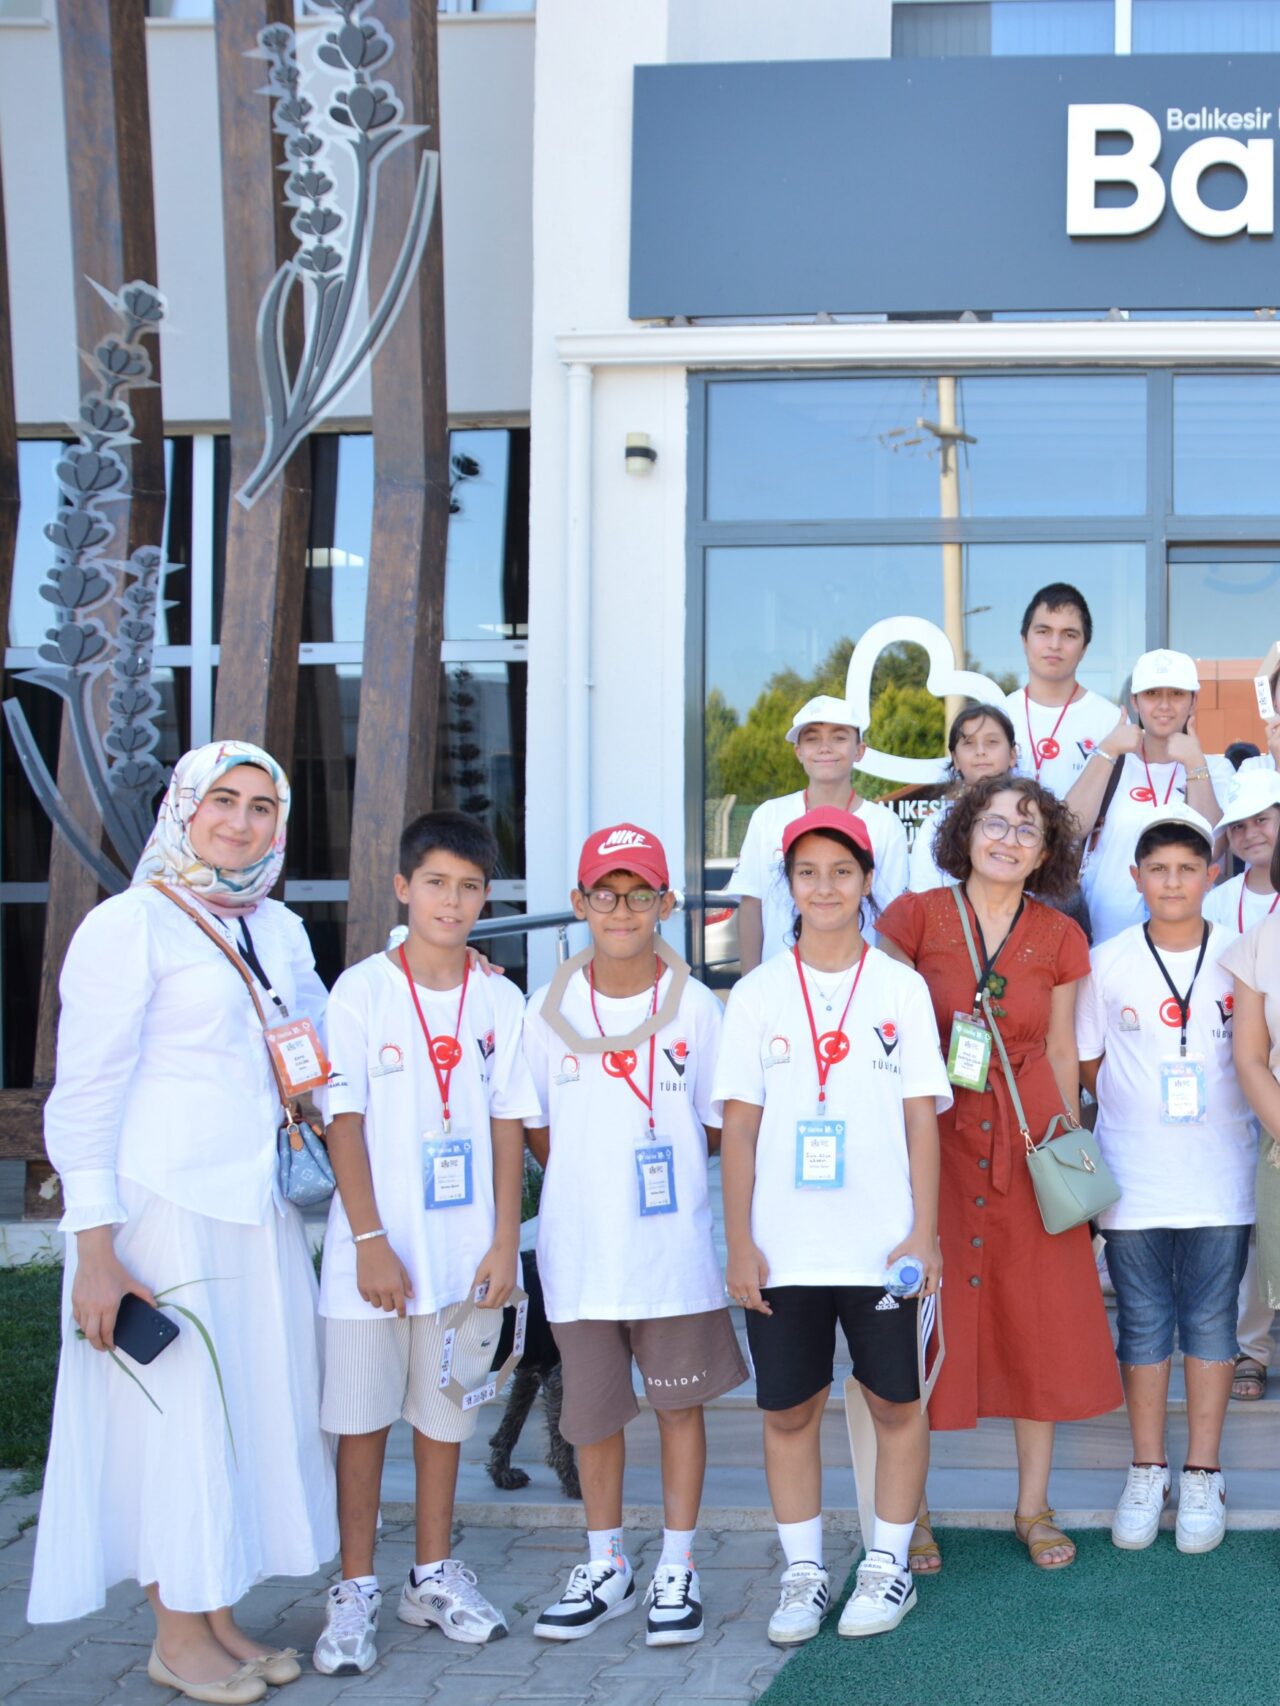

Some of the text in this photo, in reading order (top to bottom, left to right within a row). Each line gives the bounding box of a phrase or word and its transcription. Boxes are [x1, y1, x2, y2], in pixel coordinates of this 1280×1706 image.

[1166, 106, 1272, 131] Balıkesir
[606, 829, 646, 846] NIKE
[660, 1081, 688, 1092] TÜBİT
[875, 1302, 900, 1311] adidas
[647, 1370, 707, 1387] SOLIDAY
